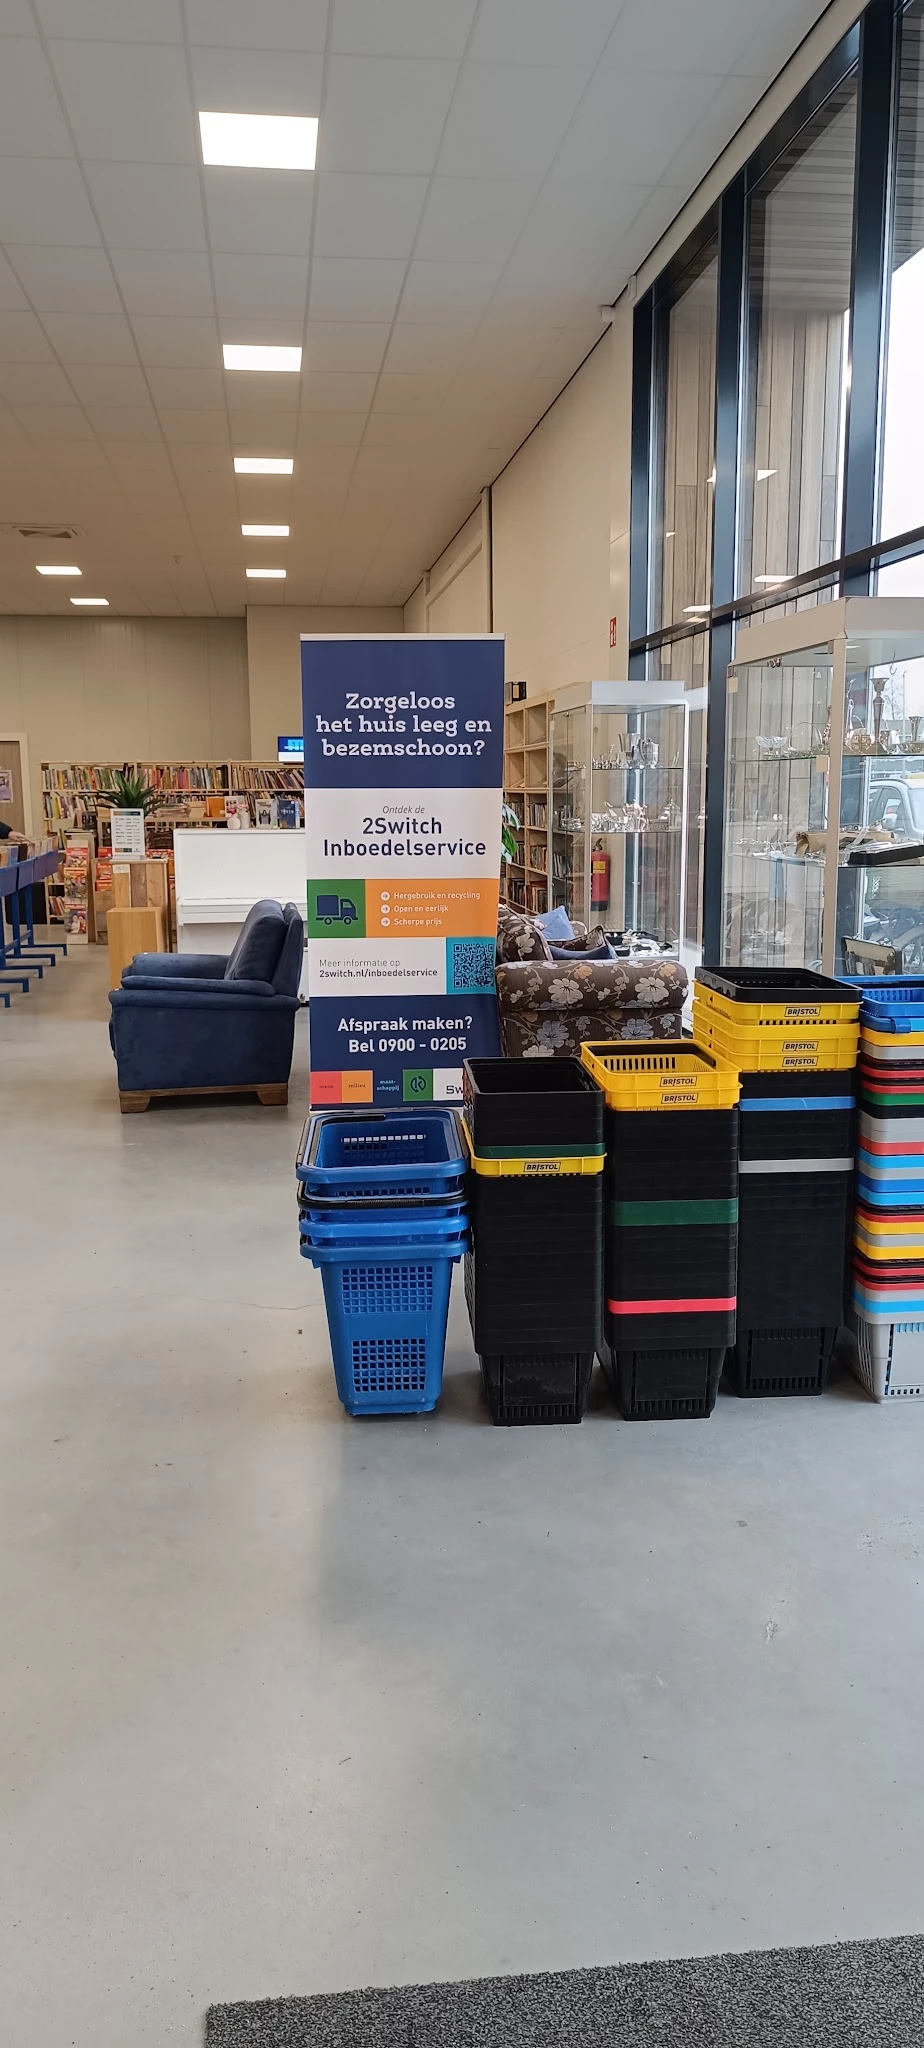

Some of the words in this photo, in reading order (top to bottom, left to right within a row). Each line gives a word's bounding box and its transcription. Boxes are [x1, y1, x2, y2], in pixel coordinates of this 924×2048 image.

[346, 692, 455, 713] Zorgeloos
[316, 715, 352, 733] het
[358, 715, 406, 733] huis
[412, 715, 458, 736] leeg
[464, 720, 492, 733] en
[322, 739, 485, 756] bezemschoon?
[382, 805, 412, 814] Ontdek
[415, 805, 425, 814] de
[362, 817, 442, 834] 2Switch
[323, 839, 486, 856] Inboedelservice
[394, 892, 435, 900] Hergebruik
[448, 892, 480, 900] recycling
[425, 905, 448, 913] eerlijk
[426, 918, 442, 926] prijs
[343, 959, 387, 967] informatie
[390, 960, 400, 968] op
[319, 968, 438, 978] 2switch.nl/inboedelservice
[338, 1017, 408, 1034] Afspraak
[412, 1016, 472, 1030] maken?
[349, 1039, 374, 1053] Bel
[379, 1038, 415, 1052] 0900
[430, 1037, 466, 1051] 0205
[663, 1078, 694, 1086] BRISTOL
[664, 1095, 696, 1103] BRISTOL
